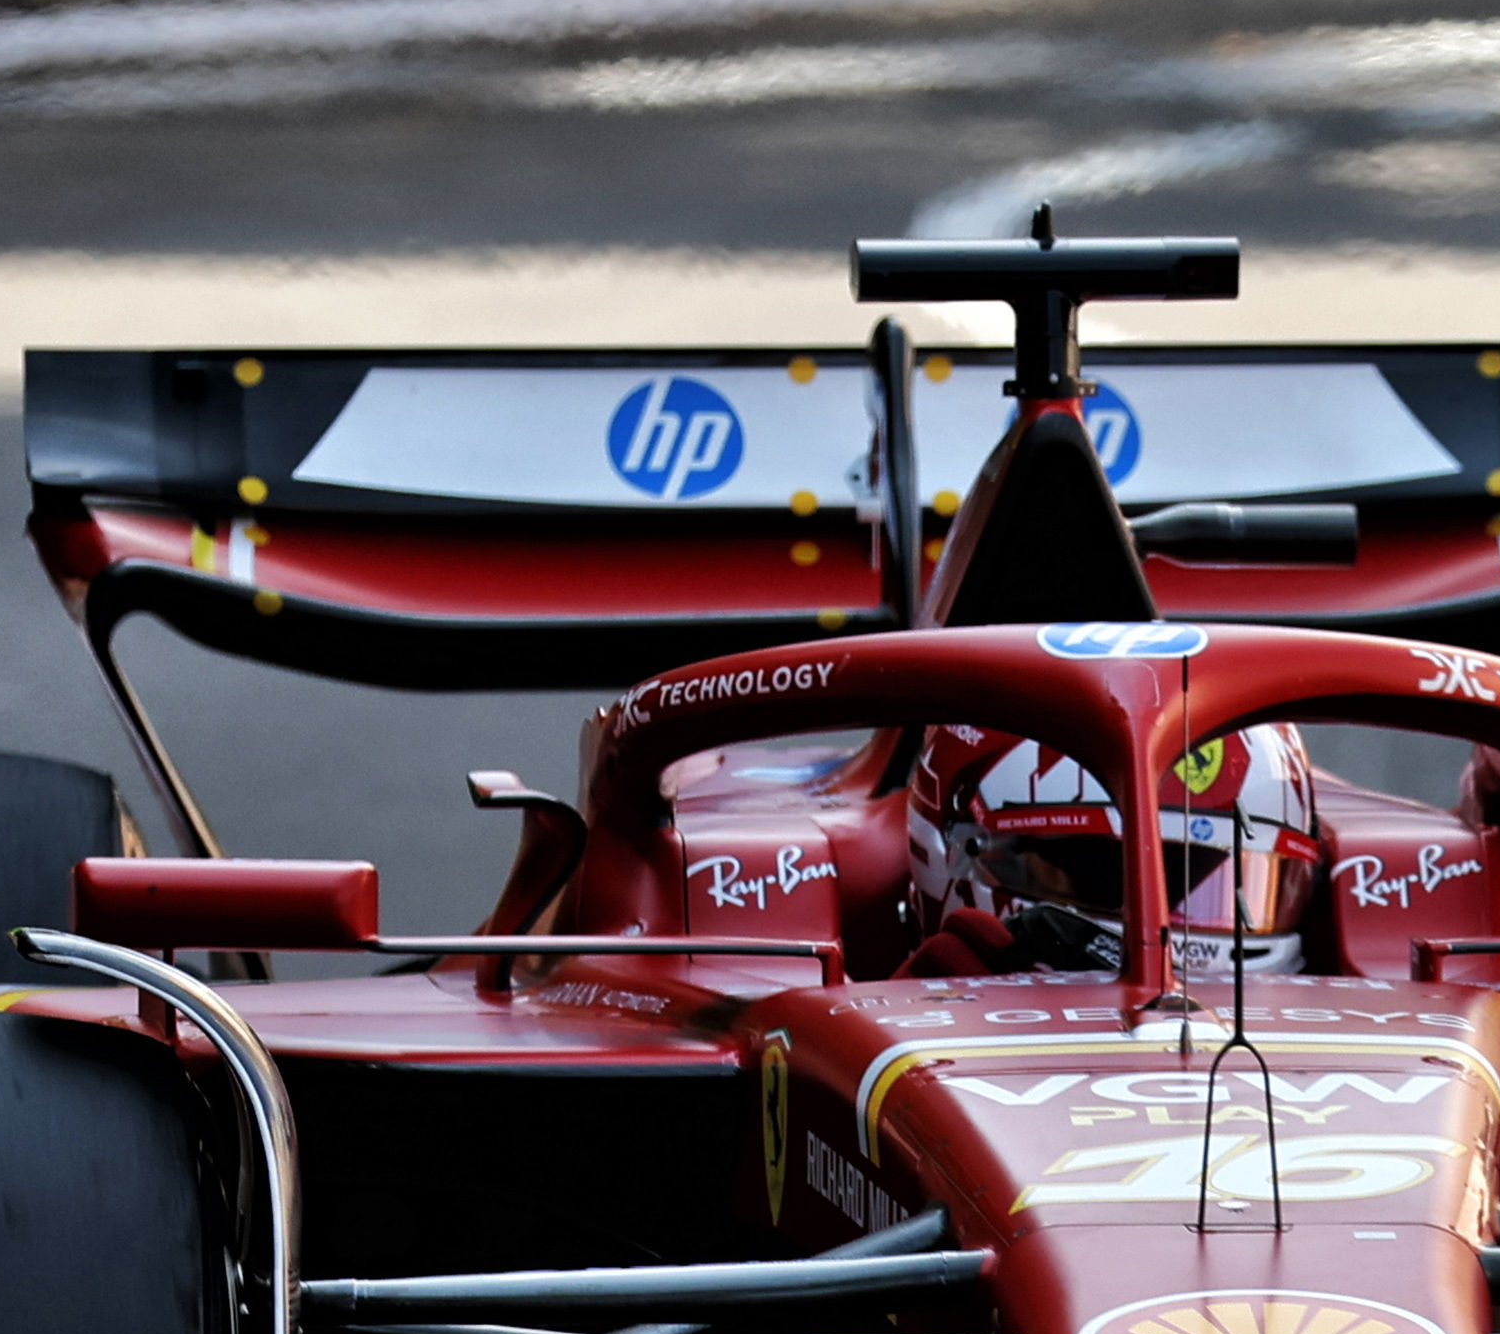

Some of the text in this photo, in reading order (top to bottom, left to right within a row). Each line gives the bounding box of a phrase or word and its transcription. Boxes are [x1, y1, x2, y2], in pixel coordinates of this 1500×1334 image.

[623, 376, 733, 501] hp
[658, 661, 835, 708] TECHNOLOGY
[1410, 648, 1497, 703] DXC
[686, 844, 838, 909] Ray-Ban
[1330, 844, 1482, 909] Ray-Ban
[984, 1005, 1477, 1032] GEESYS
[938, 1070, 1455, 1106] VGW
[1067, 1104, 1349, 1126] PLAY
[807, 1129, 865, 1229] RICHARD
[1008, 1132, 1468, 1217] 16
